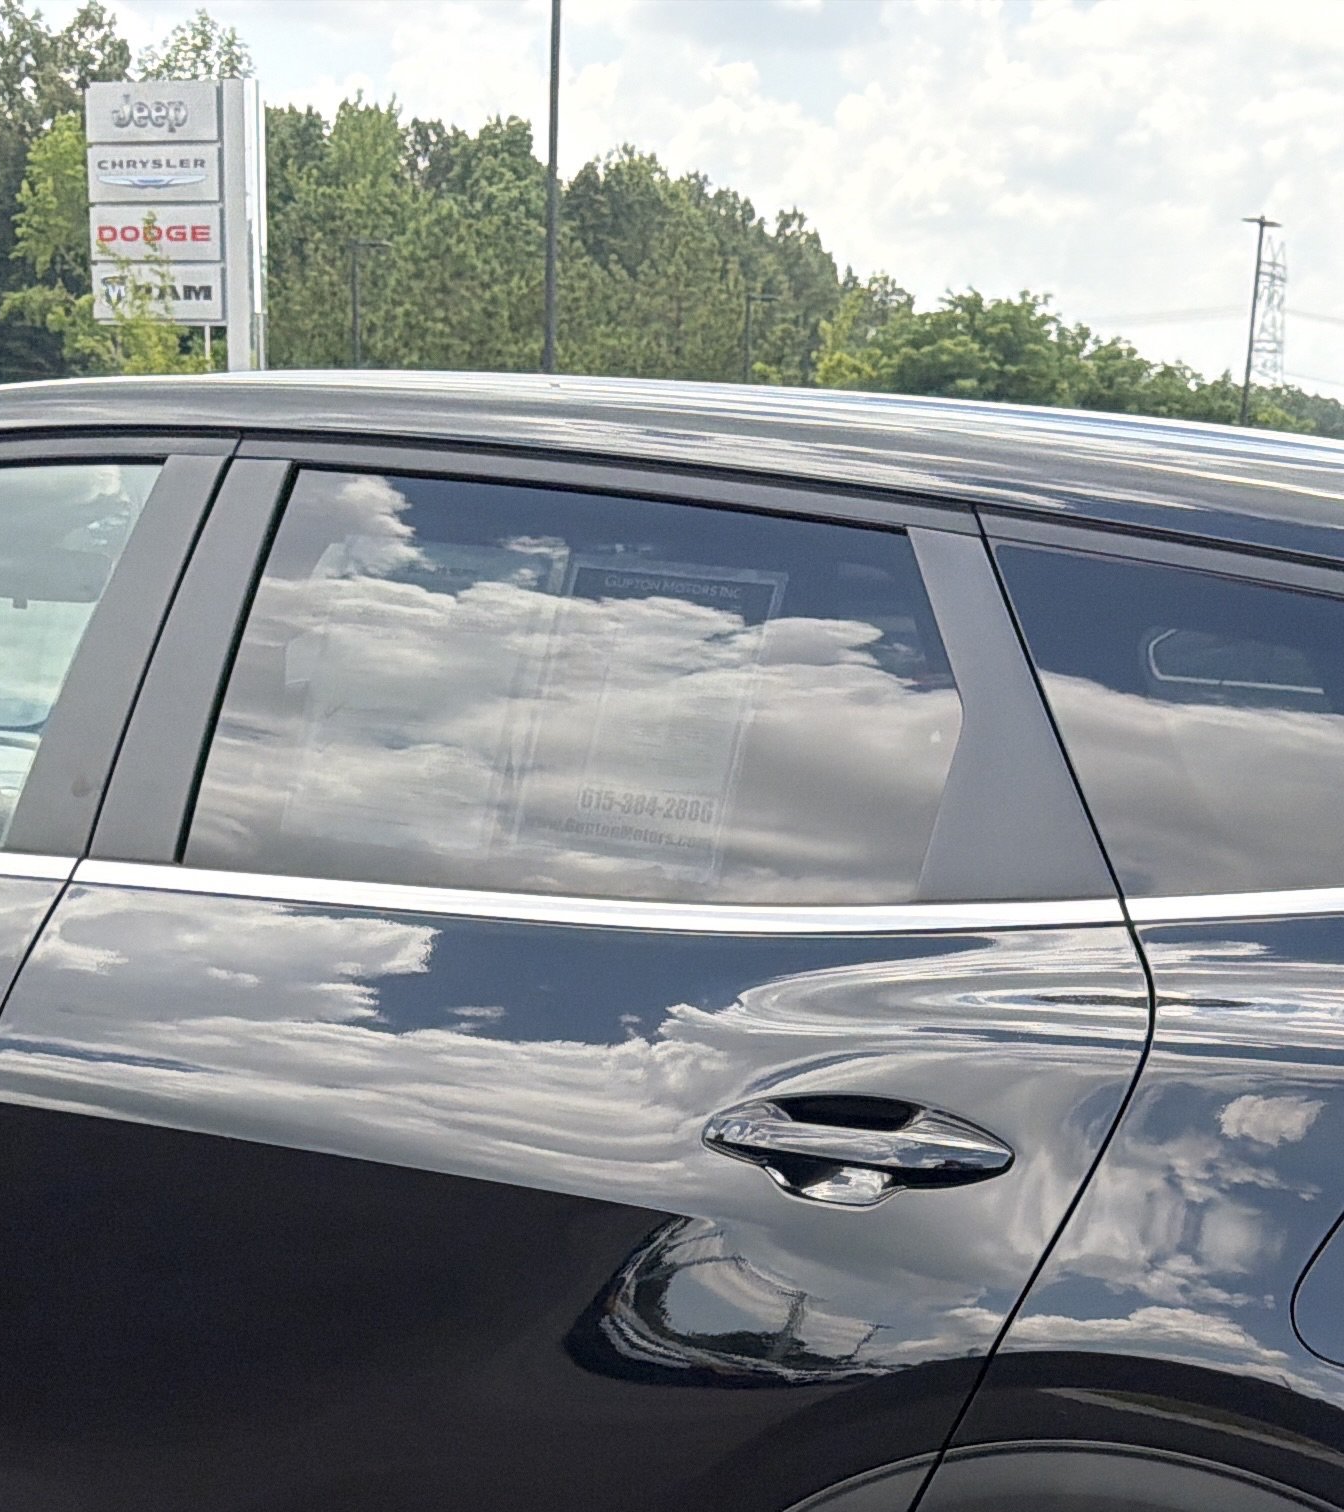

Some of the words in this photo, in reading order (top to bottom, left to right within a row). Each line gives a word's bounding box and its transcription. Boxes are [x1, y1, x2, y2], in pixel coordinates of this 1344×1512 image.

[112, 93, 188, 133] Jeep
[97, 158, 206, 170] CHRYSLER
[97, 225, 211, 241] DODGE
